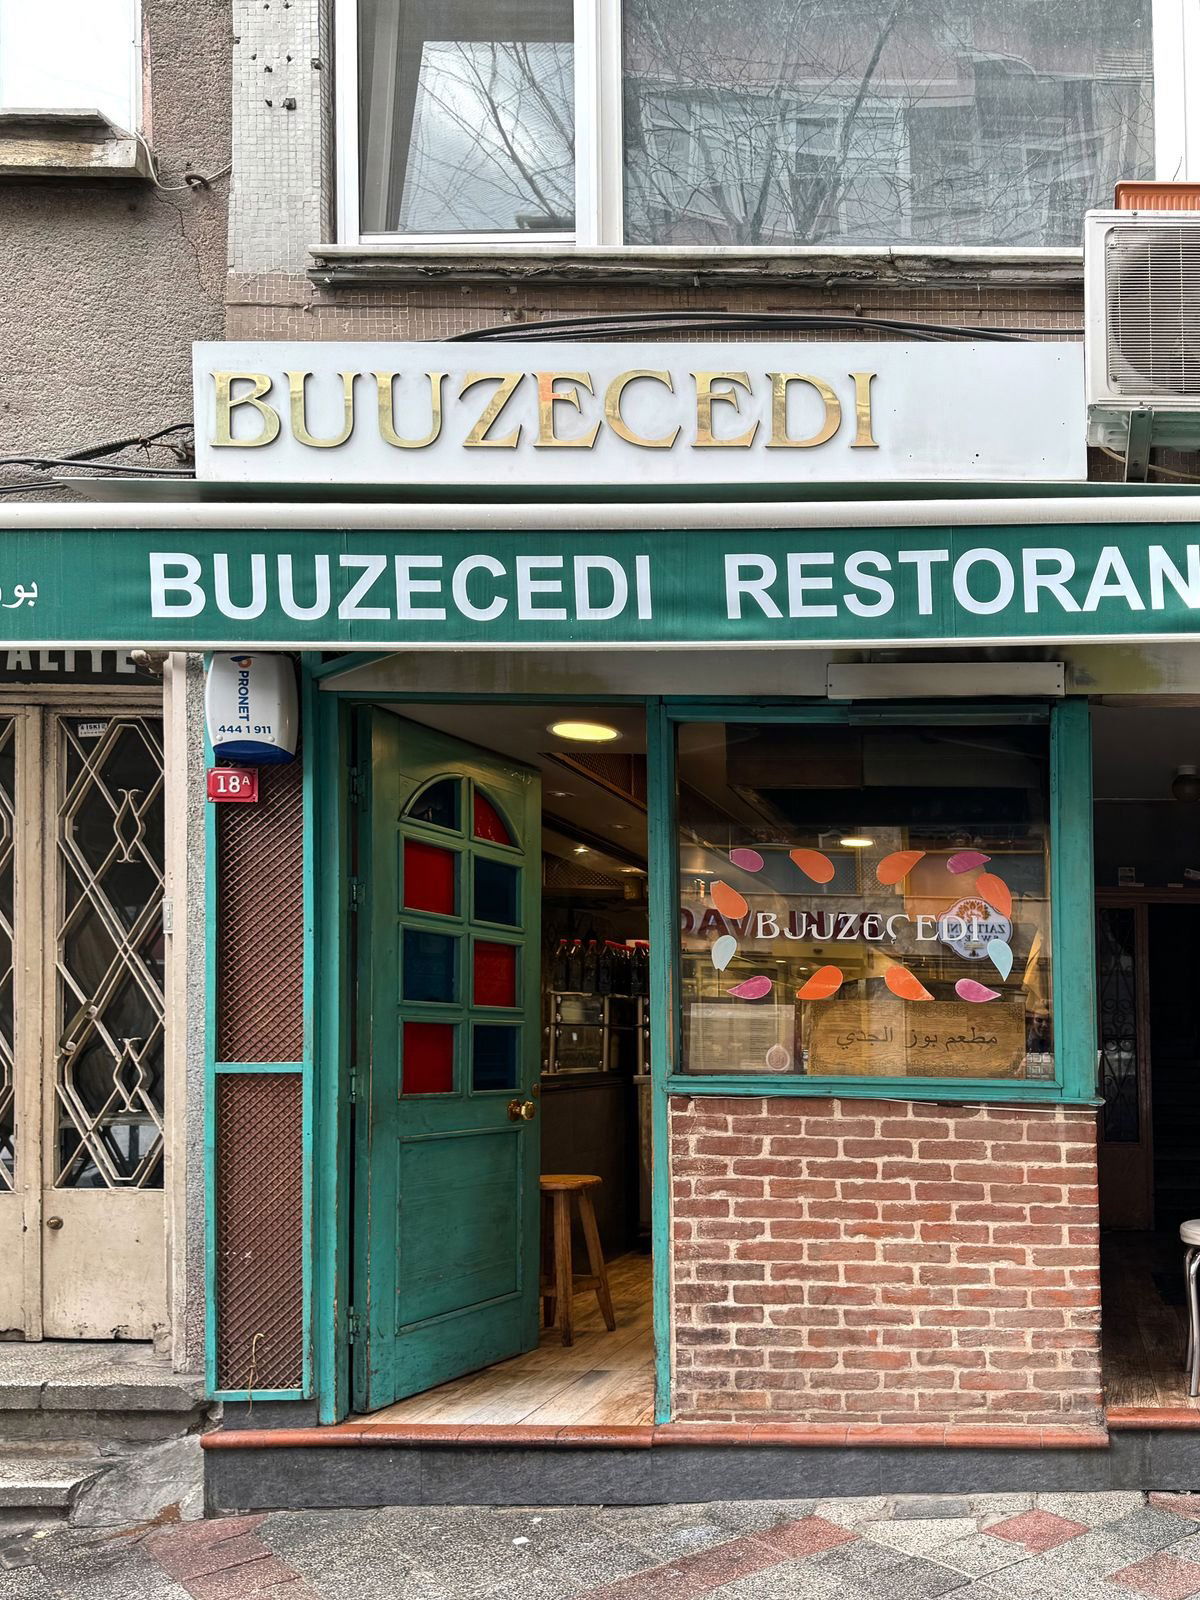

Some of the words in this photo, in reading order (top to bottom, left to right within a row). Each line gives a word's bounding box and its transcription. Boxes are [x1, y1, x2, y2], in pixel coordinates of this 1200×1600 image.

[208, 370, 880, 449] BUUZECEDI
[0, 581, 38, 609] بو
[149, 552, 652, 622] BUUZECEDI
[724, 544, 1200, 620] RESTORAN
[238, 670, 250, 722] PRONET
[218, 725, 242, 734] 444
[245, 725, 251, 734] 1
[254, 725, 272, 735] 911
[836, 1026, 893, 1050] الجدي
[945, 1027, 998, 1050] مطعم
